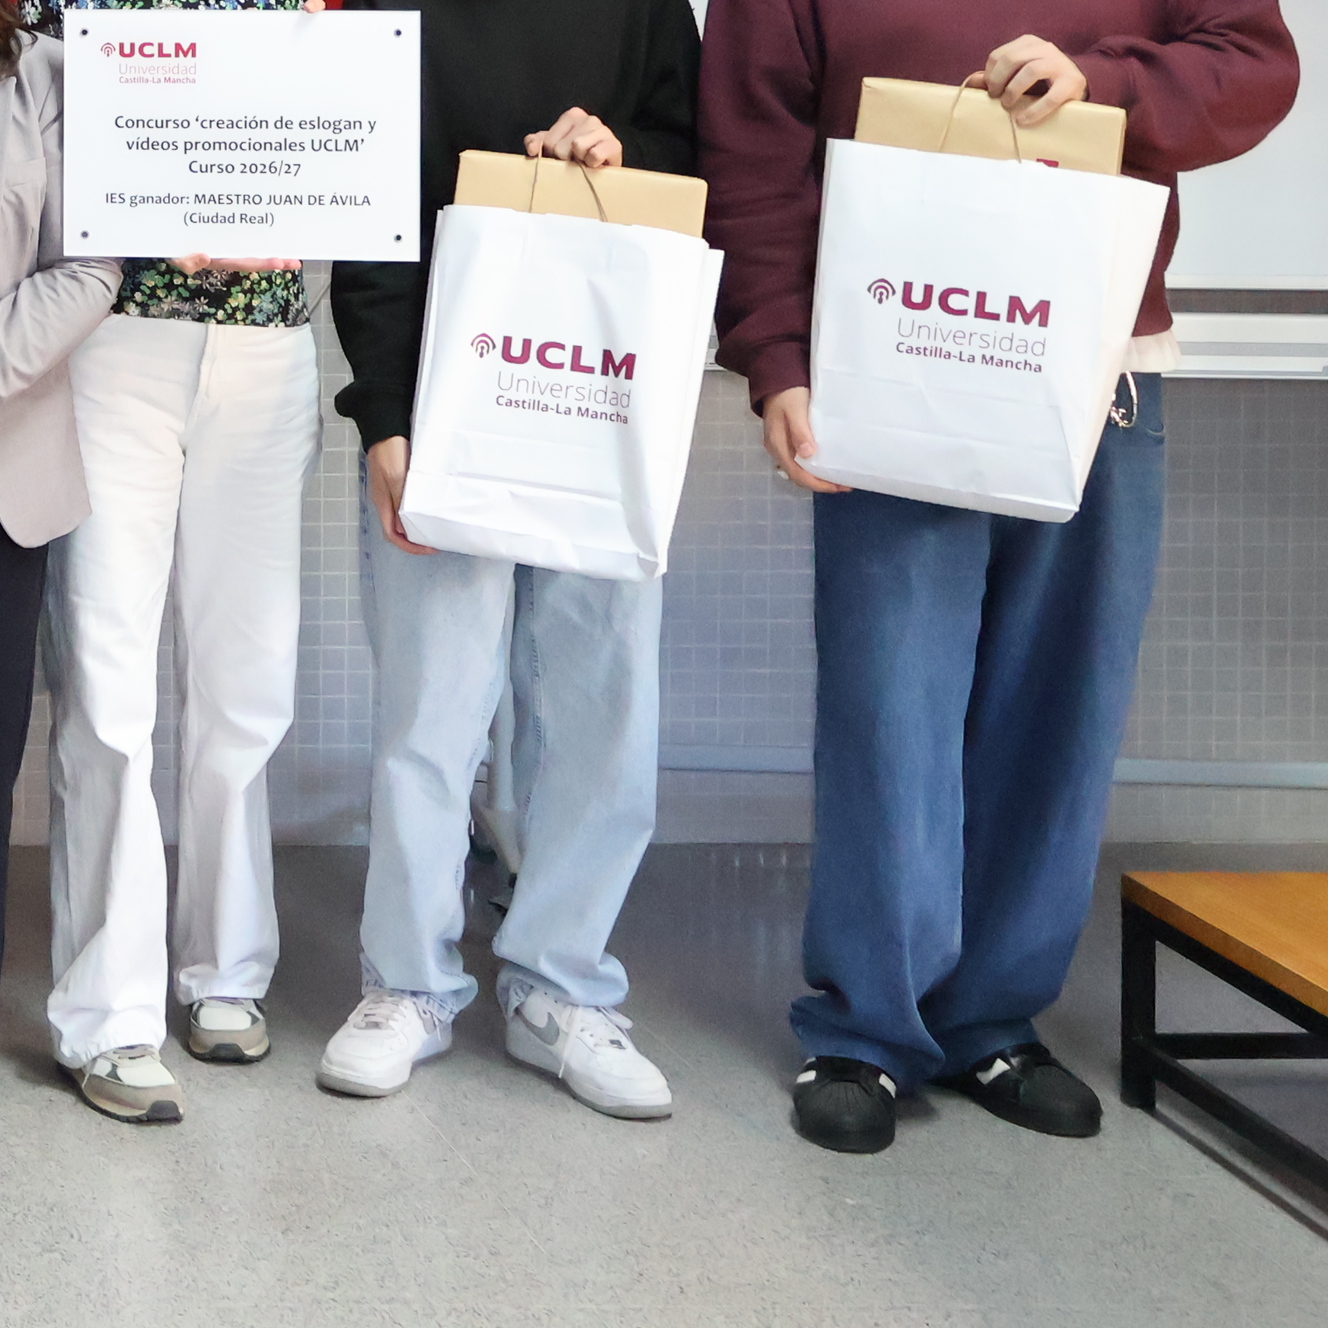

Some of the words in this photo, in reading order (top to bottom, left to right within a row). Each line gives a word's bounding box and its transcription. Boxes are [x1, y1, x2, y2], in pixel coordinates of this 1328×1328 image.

[118, 42, 197, 58] UCLM
[118, 62, 197, 75] Universidad
[118, 76, 162, 84] Castilla-La
[163, 76, 196, 84] Mancha
[114, 115, 191, 129] Concurso
[274, 115, 294, 130] de
[298, 116, 363, 134] eslogan
[367, 120, 377, 134] y
[126, 137, 179, 151] vídeos
[183, 138, 306, 155] promocionales
[188, 160, 235, 174] Curso
[240, 160, 301, 176] 2026/27
[105, 193, 126, 204] IES
[129, 193, 190, 207] ganador:
[194, 193, 263, 205] MAESTRO
[266, 194, 303, 206] JUAN
[308, 194, 326, 206] DE
[329, 192, 371, 206] ÁVILA
[183, 211, 236, 226] (Ciudad
[239, 212, 275, 227] Real)
[901, 281, 1051, 328] UCLM
[897, 317, 1046, 357] Universidad
[501, 335, 637, 380] UCLM
[896, 342, 976, 363] Castilla-La
[980, 354, 1043, 373] Mancha
[497, 371, 632, 408] Universidad
[496, 395, 572, 415] Castilla-La
[576, 406, 629, 424] Mancha
